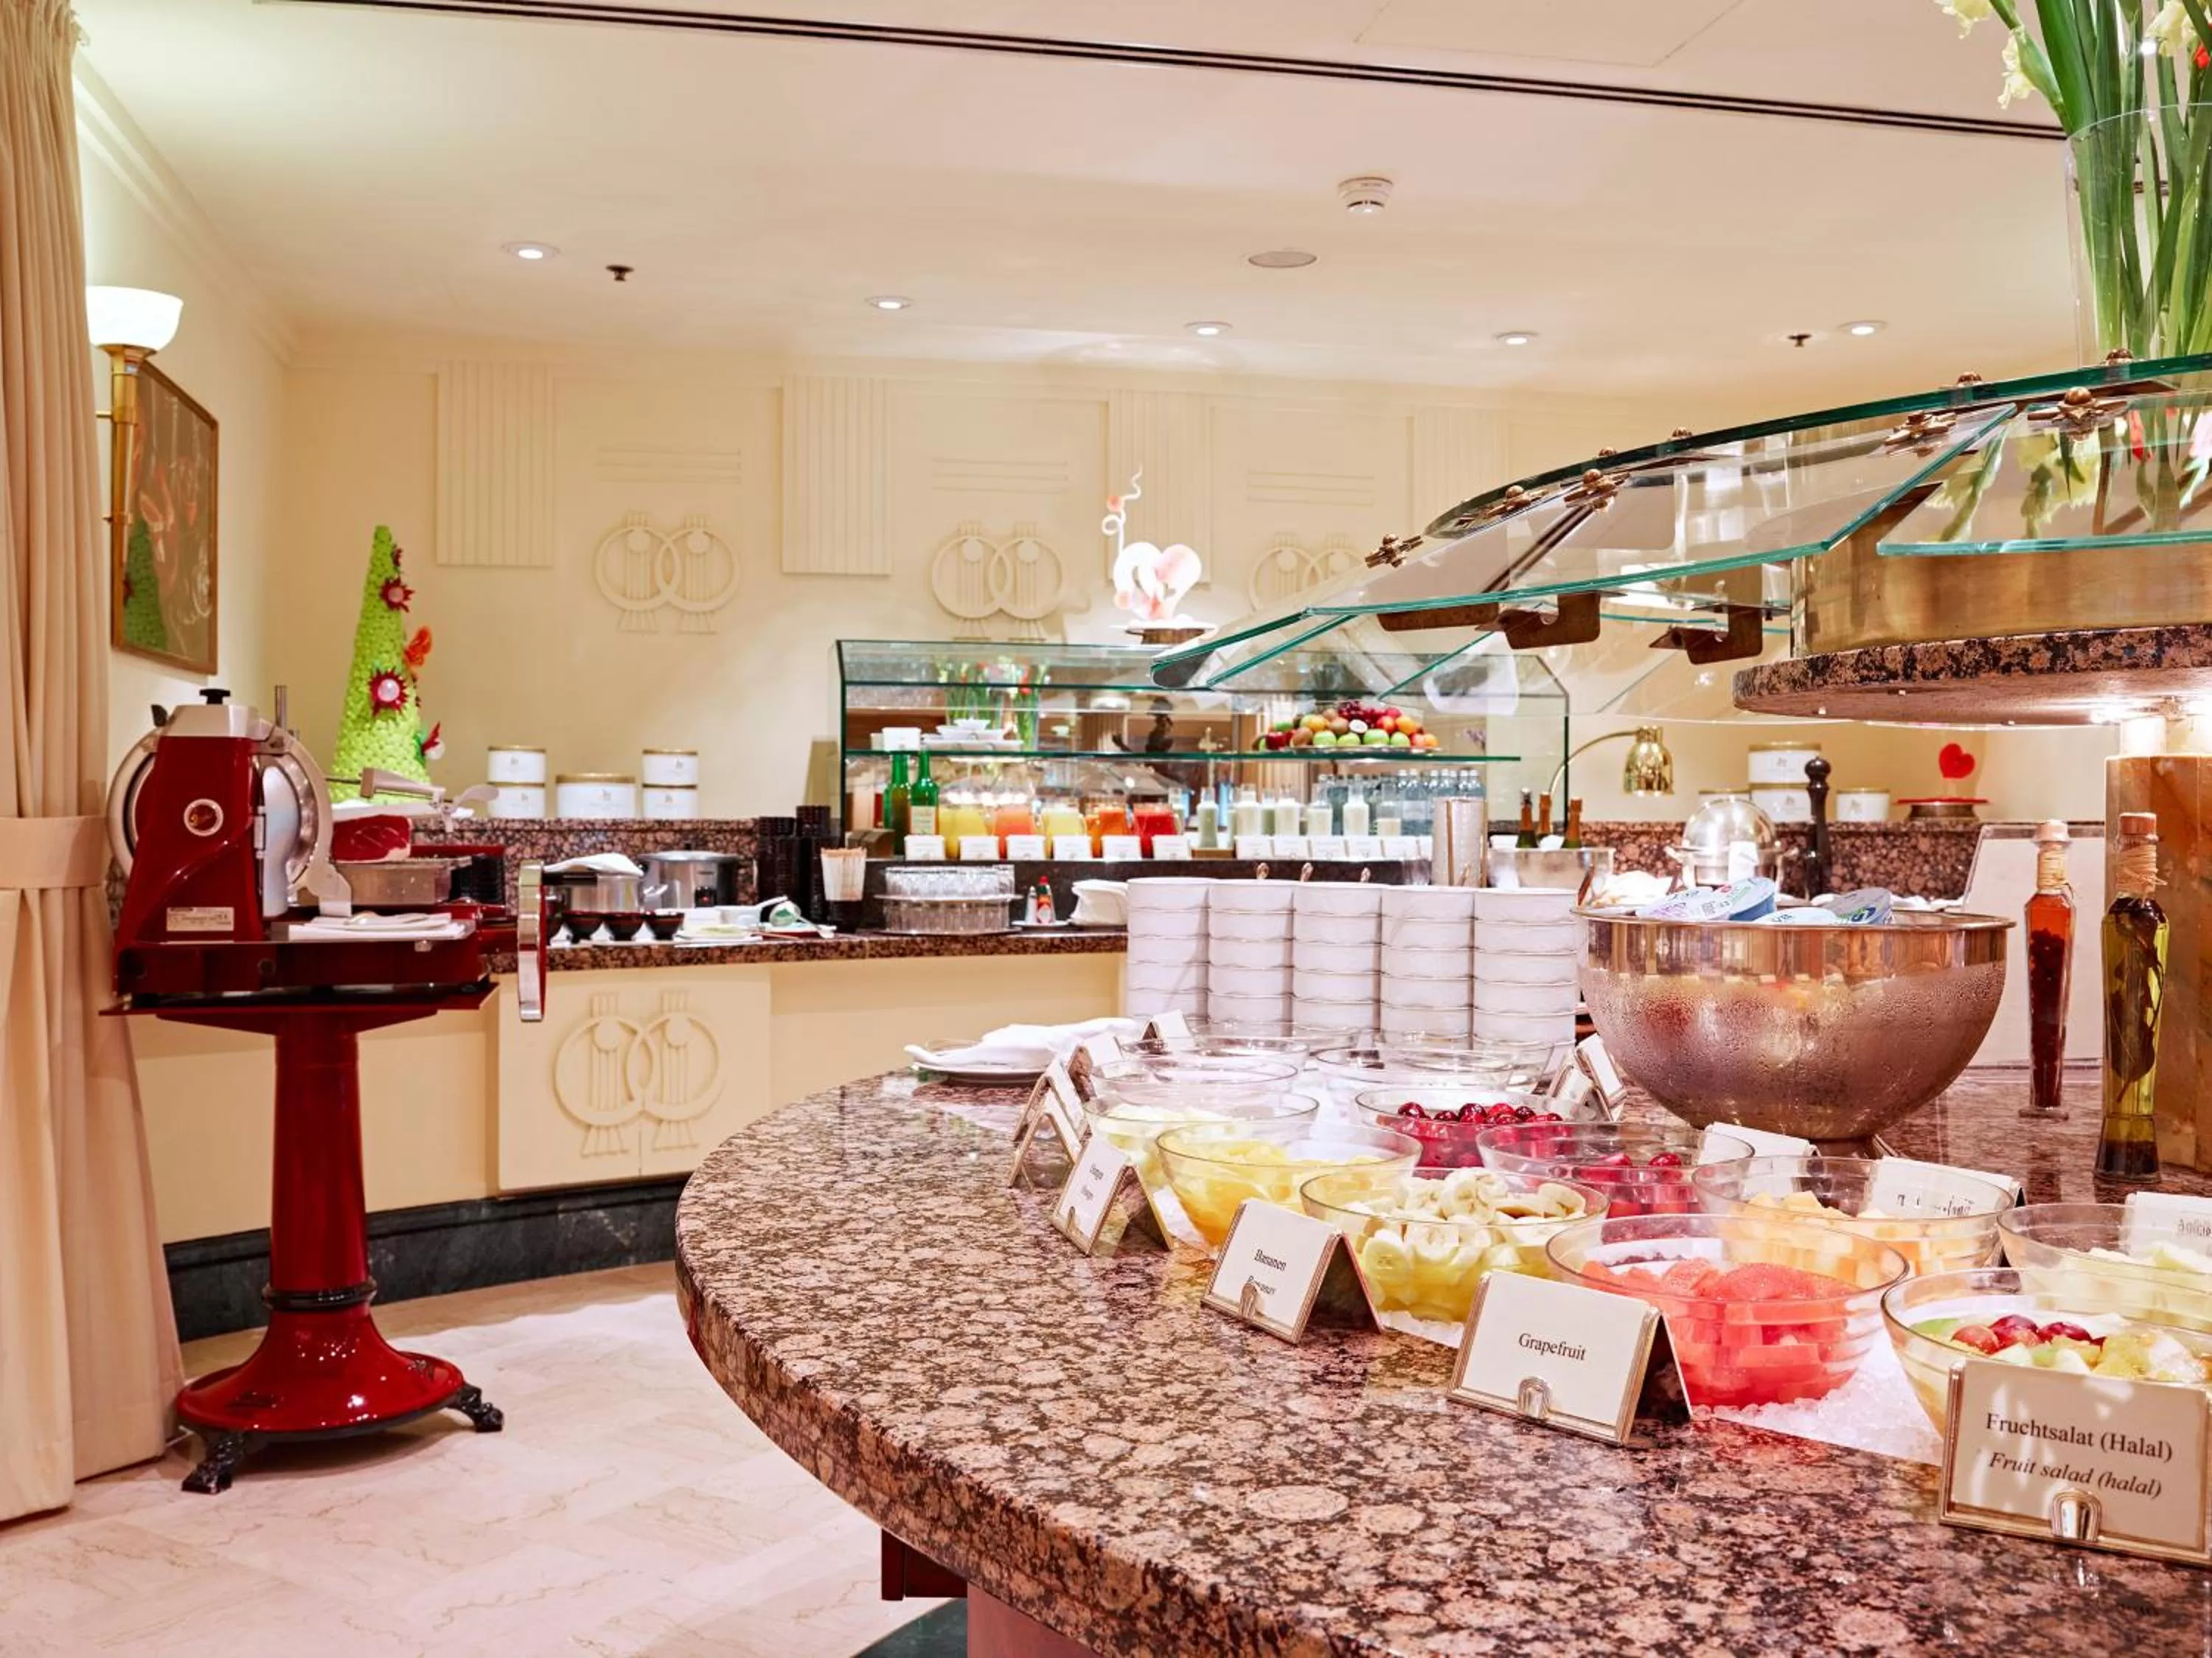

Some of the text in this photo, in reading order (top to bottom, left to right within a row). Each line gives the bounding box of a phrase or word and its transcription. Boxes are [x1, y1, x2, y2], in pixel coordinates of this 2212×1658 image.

[1518, 1333, 1586, 1361] Grapefruit
[1986, 1412, 2174, 1463] Fruchtsalat (Halal)
[1988, 1452, 2162, 1499] Fruit salad (halal)
